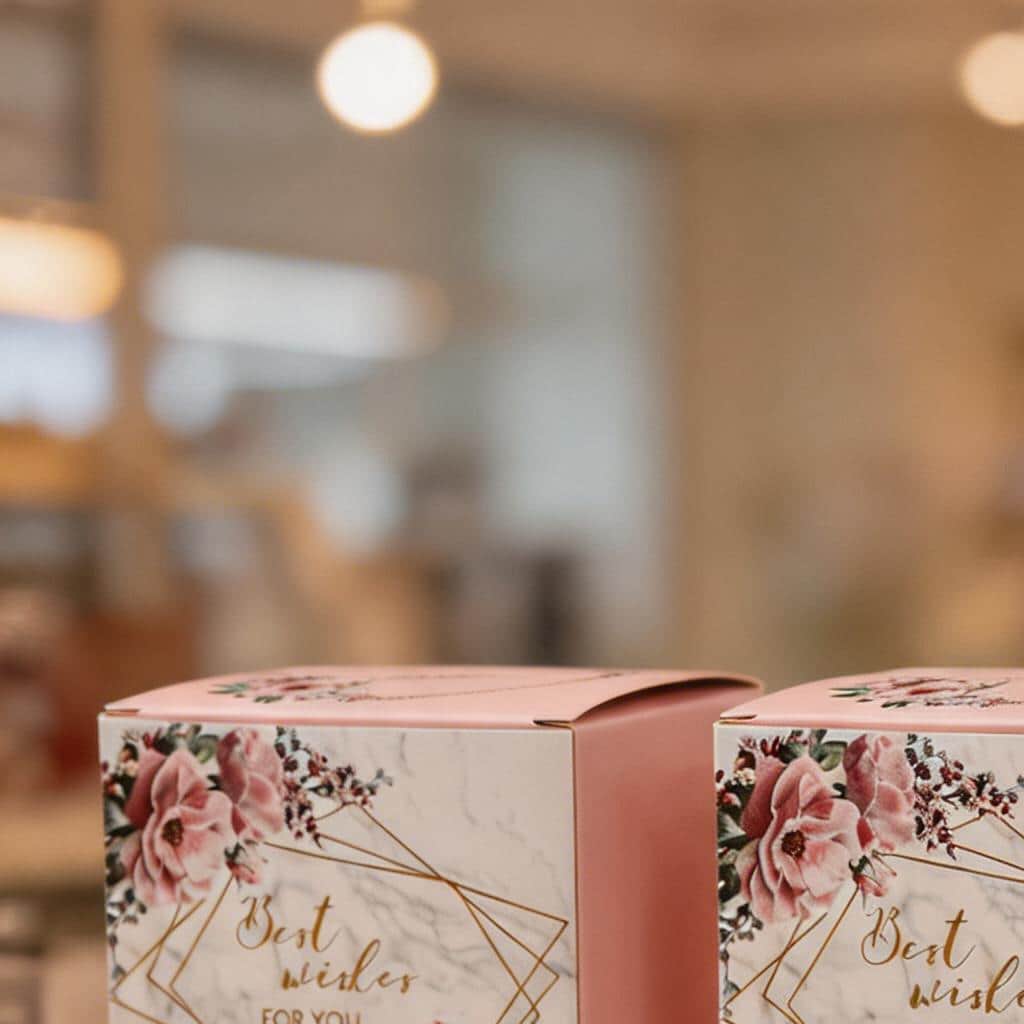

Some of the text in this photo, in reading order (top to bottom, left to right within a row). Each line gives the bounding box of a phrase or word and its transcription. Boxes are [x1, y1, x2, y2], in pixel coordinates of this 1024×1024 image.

[236, 895, 340, 952] Best
[861, 906, 976, 969] Best
[281, 938, 418, 993] wishes
